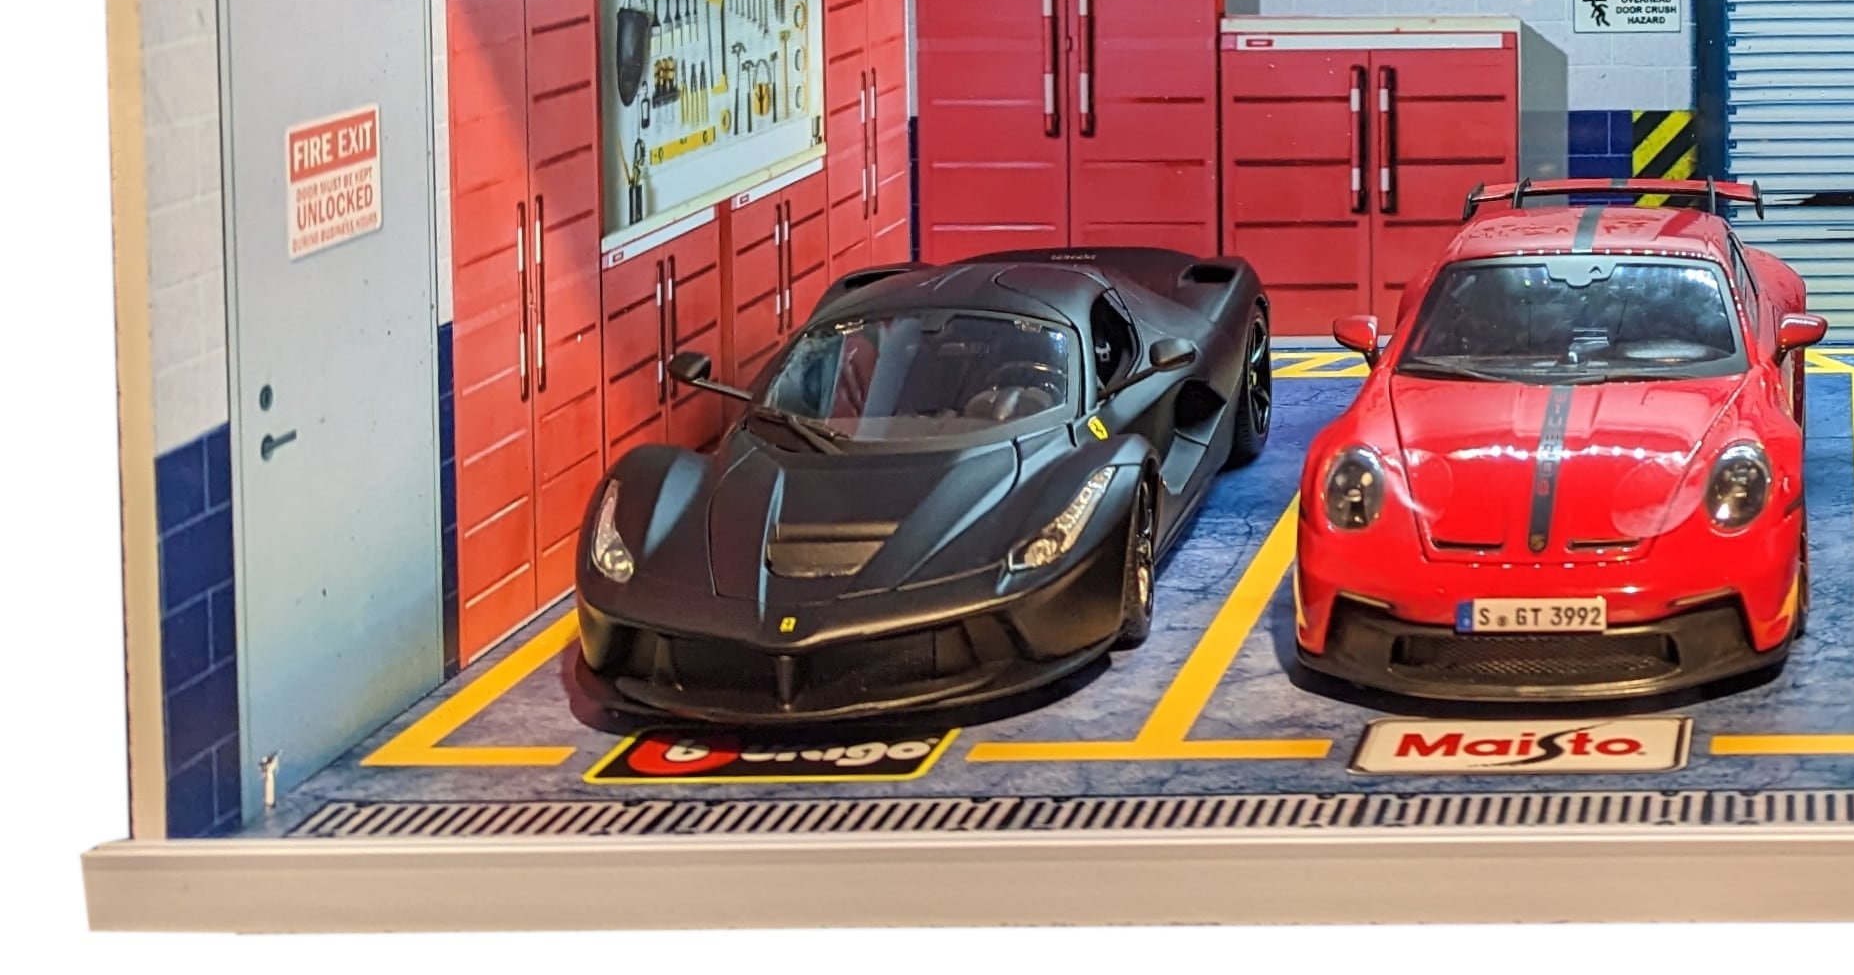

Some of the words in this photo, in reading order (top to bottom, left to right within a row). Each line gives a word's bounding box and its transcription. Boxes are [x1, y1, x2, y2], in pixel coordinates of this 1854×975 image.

[1615, 6, 1643, 14] DOOR
[1645, 6, 1677, 14] CRUSH
[1627, 16, 1666, 25] HAZARD
[293, 130, 334, 174] FIRE
[337, 119, 374, 159] EXIT
[296, 183, 374, 232] UNLOCKED
[1478, 607, 1491, 626] S
[1515, 607, 1542, 626] GT
[1550, 606, 1602, 626] 3992
